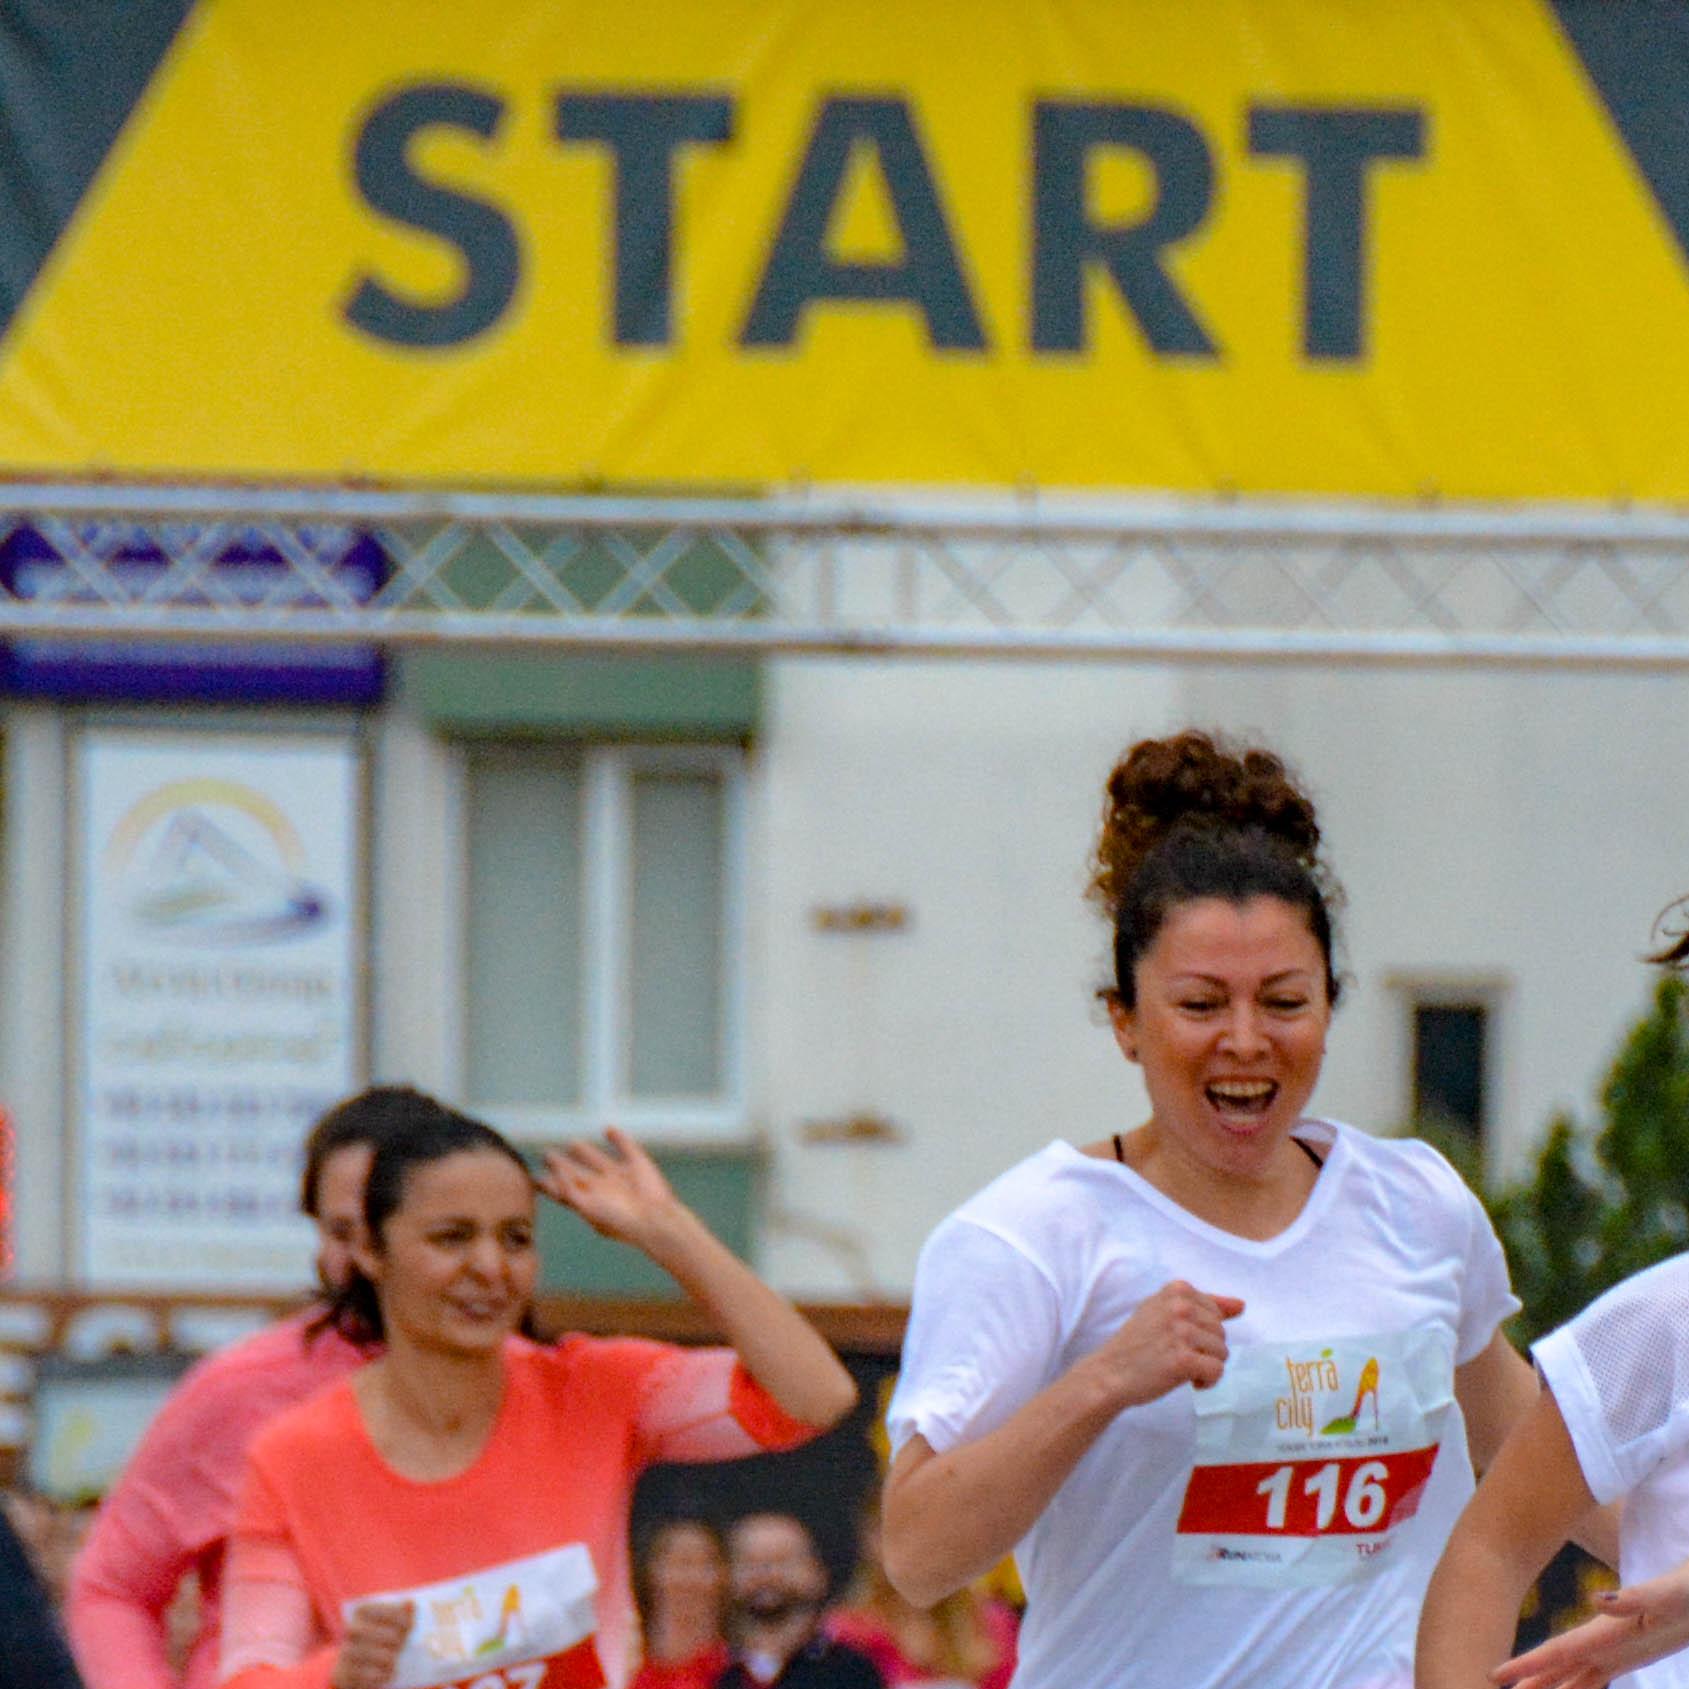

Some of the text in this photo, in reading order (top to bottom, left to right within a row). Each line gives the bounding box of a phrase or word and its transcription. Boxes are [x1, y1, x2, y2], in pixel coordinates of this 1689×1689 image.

[338, 78, 1430, 364] START
[1285, 1356, 1338, 1392] terra
[1256, 1460, 1389, 1530] 116
